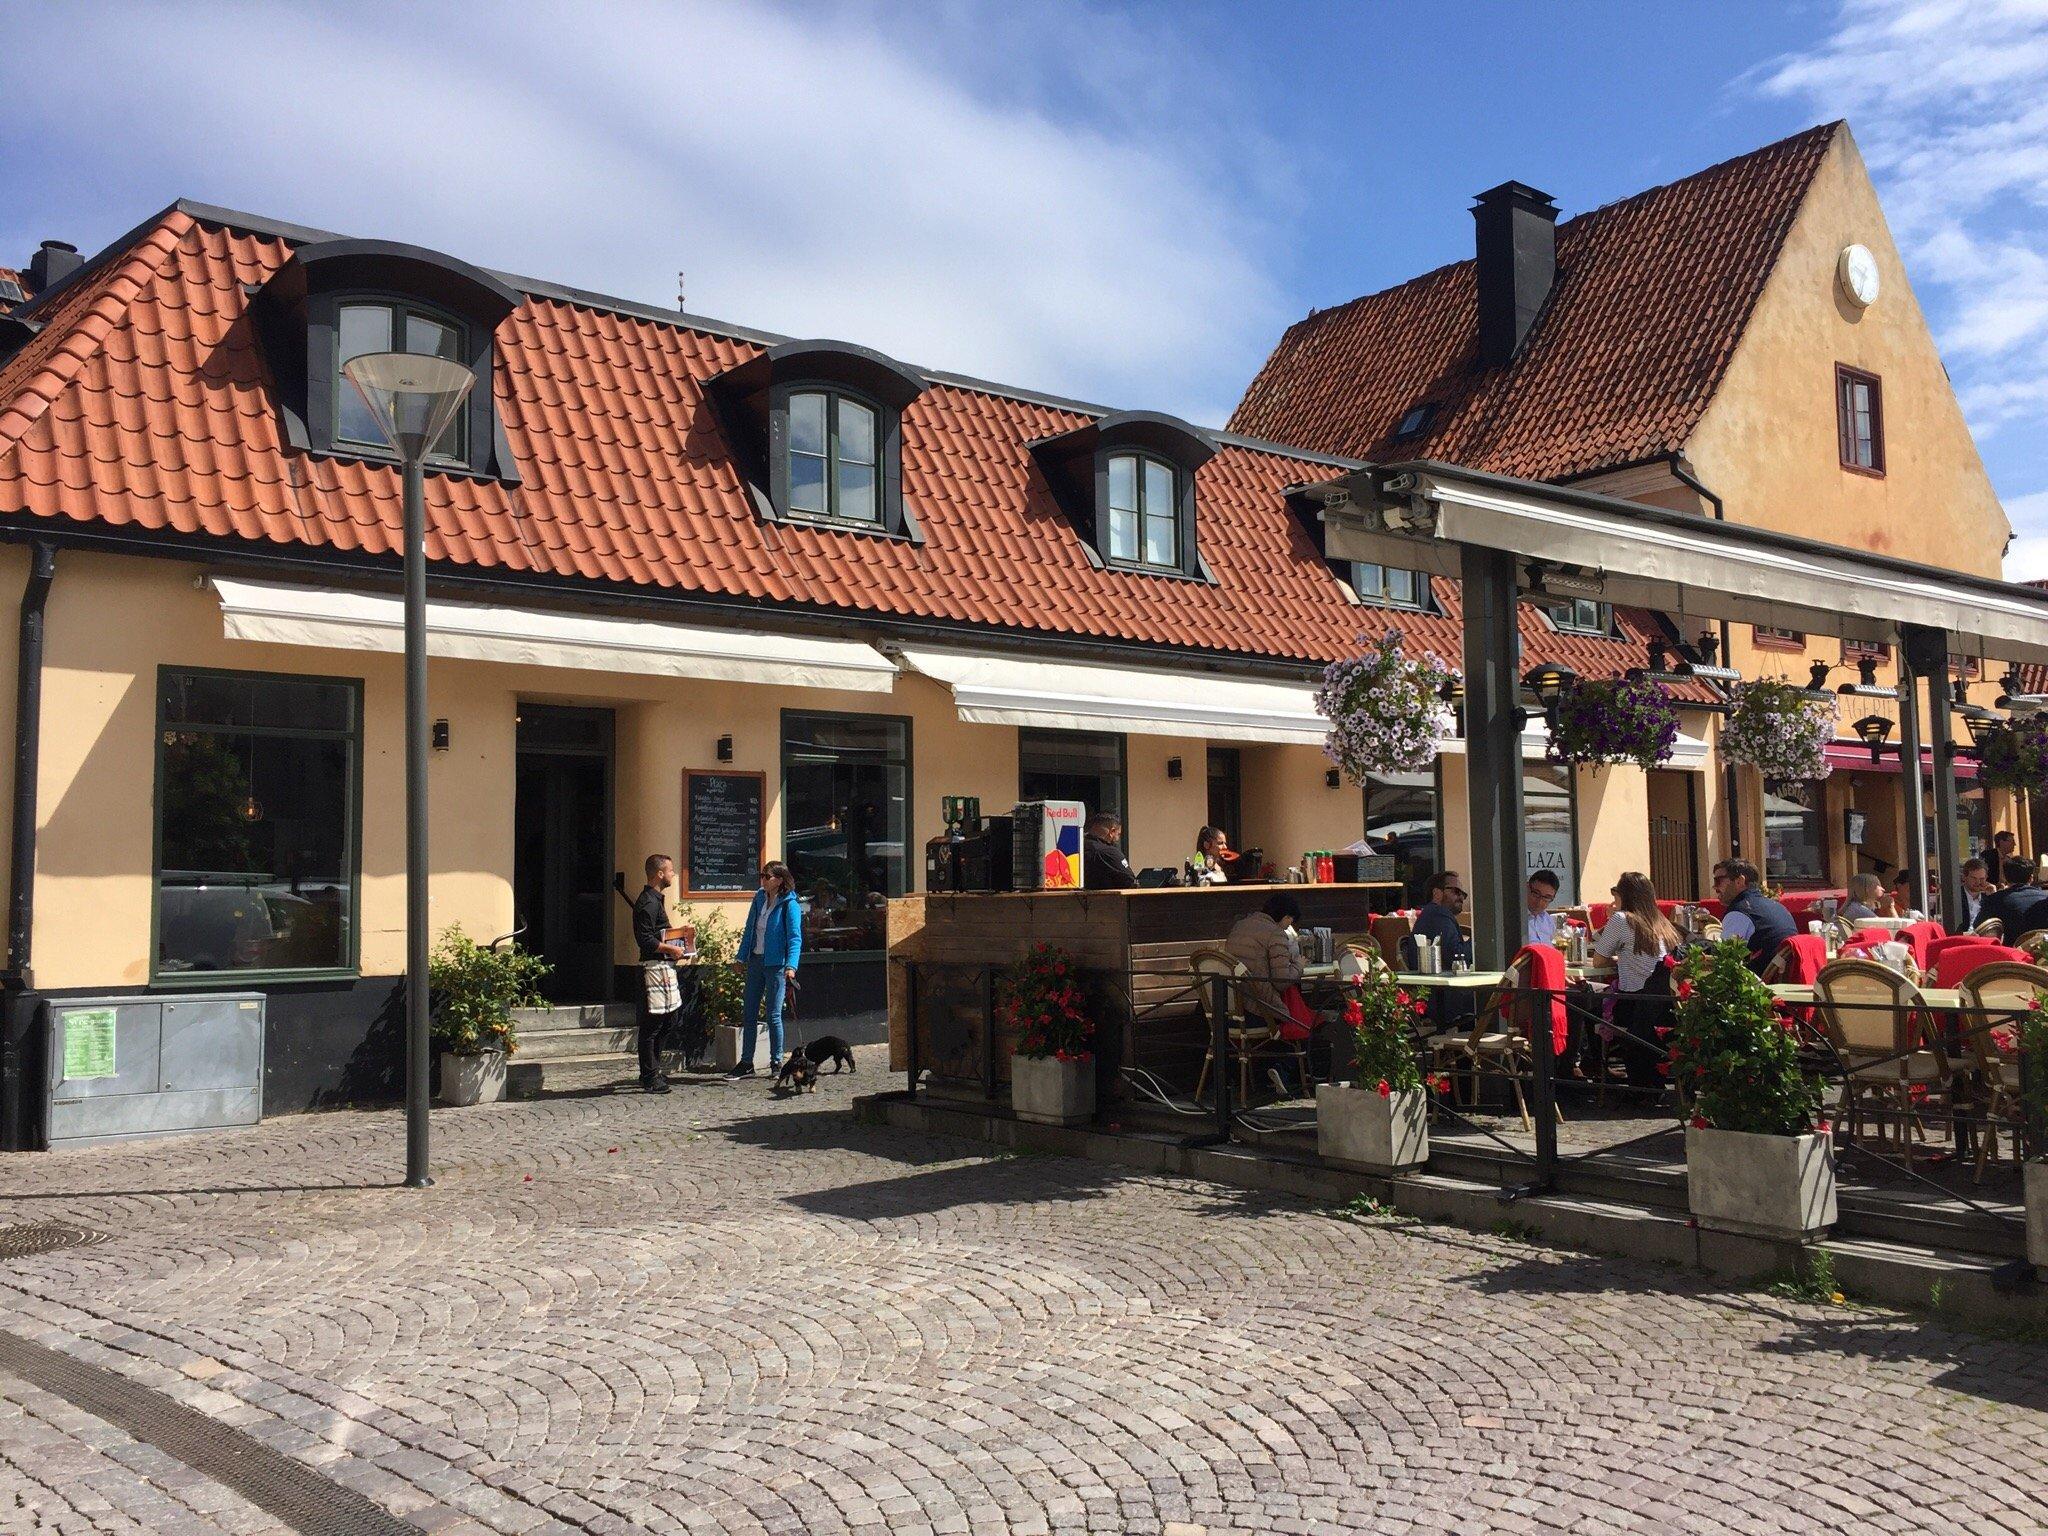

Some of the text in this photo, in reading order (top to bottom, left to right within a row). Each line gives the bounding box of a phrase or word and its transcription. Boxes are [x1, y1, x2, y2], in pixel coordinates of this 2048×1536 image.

[1842, 695, 1895, 719] AGERIE
[1046, 808, 1078, 818] Red Bull
[1526, 852, 1566, 868] LAZA
